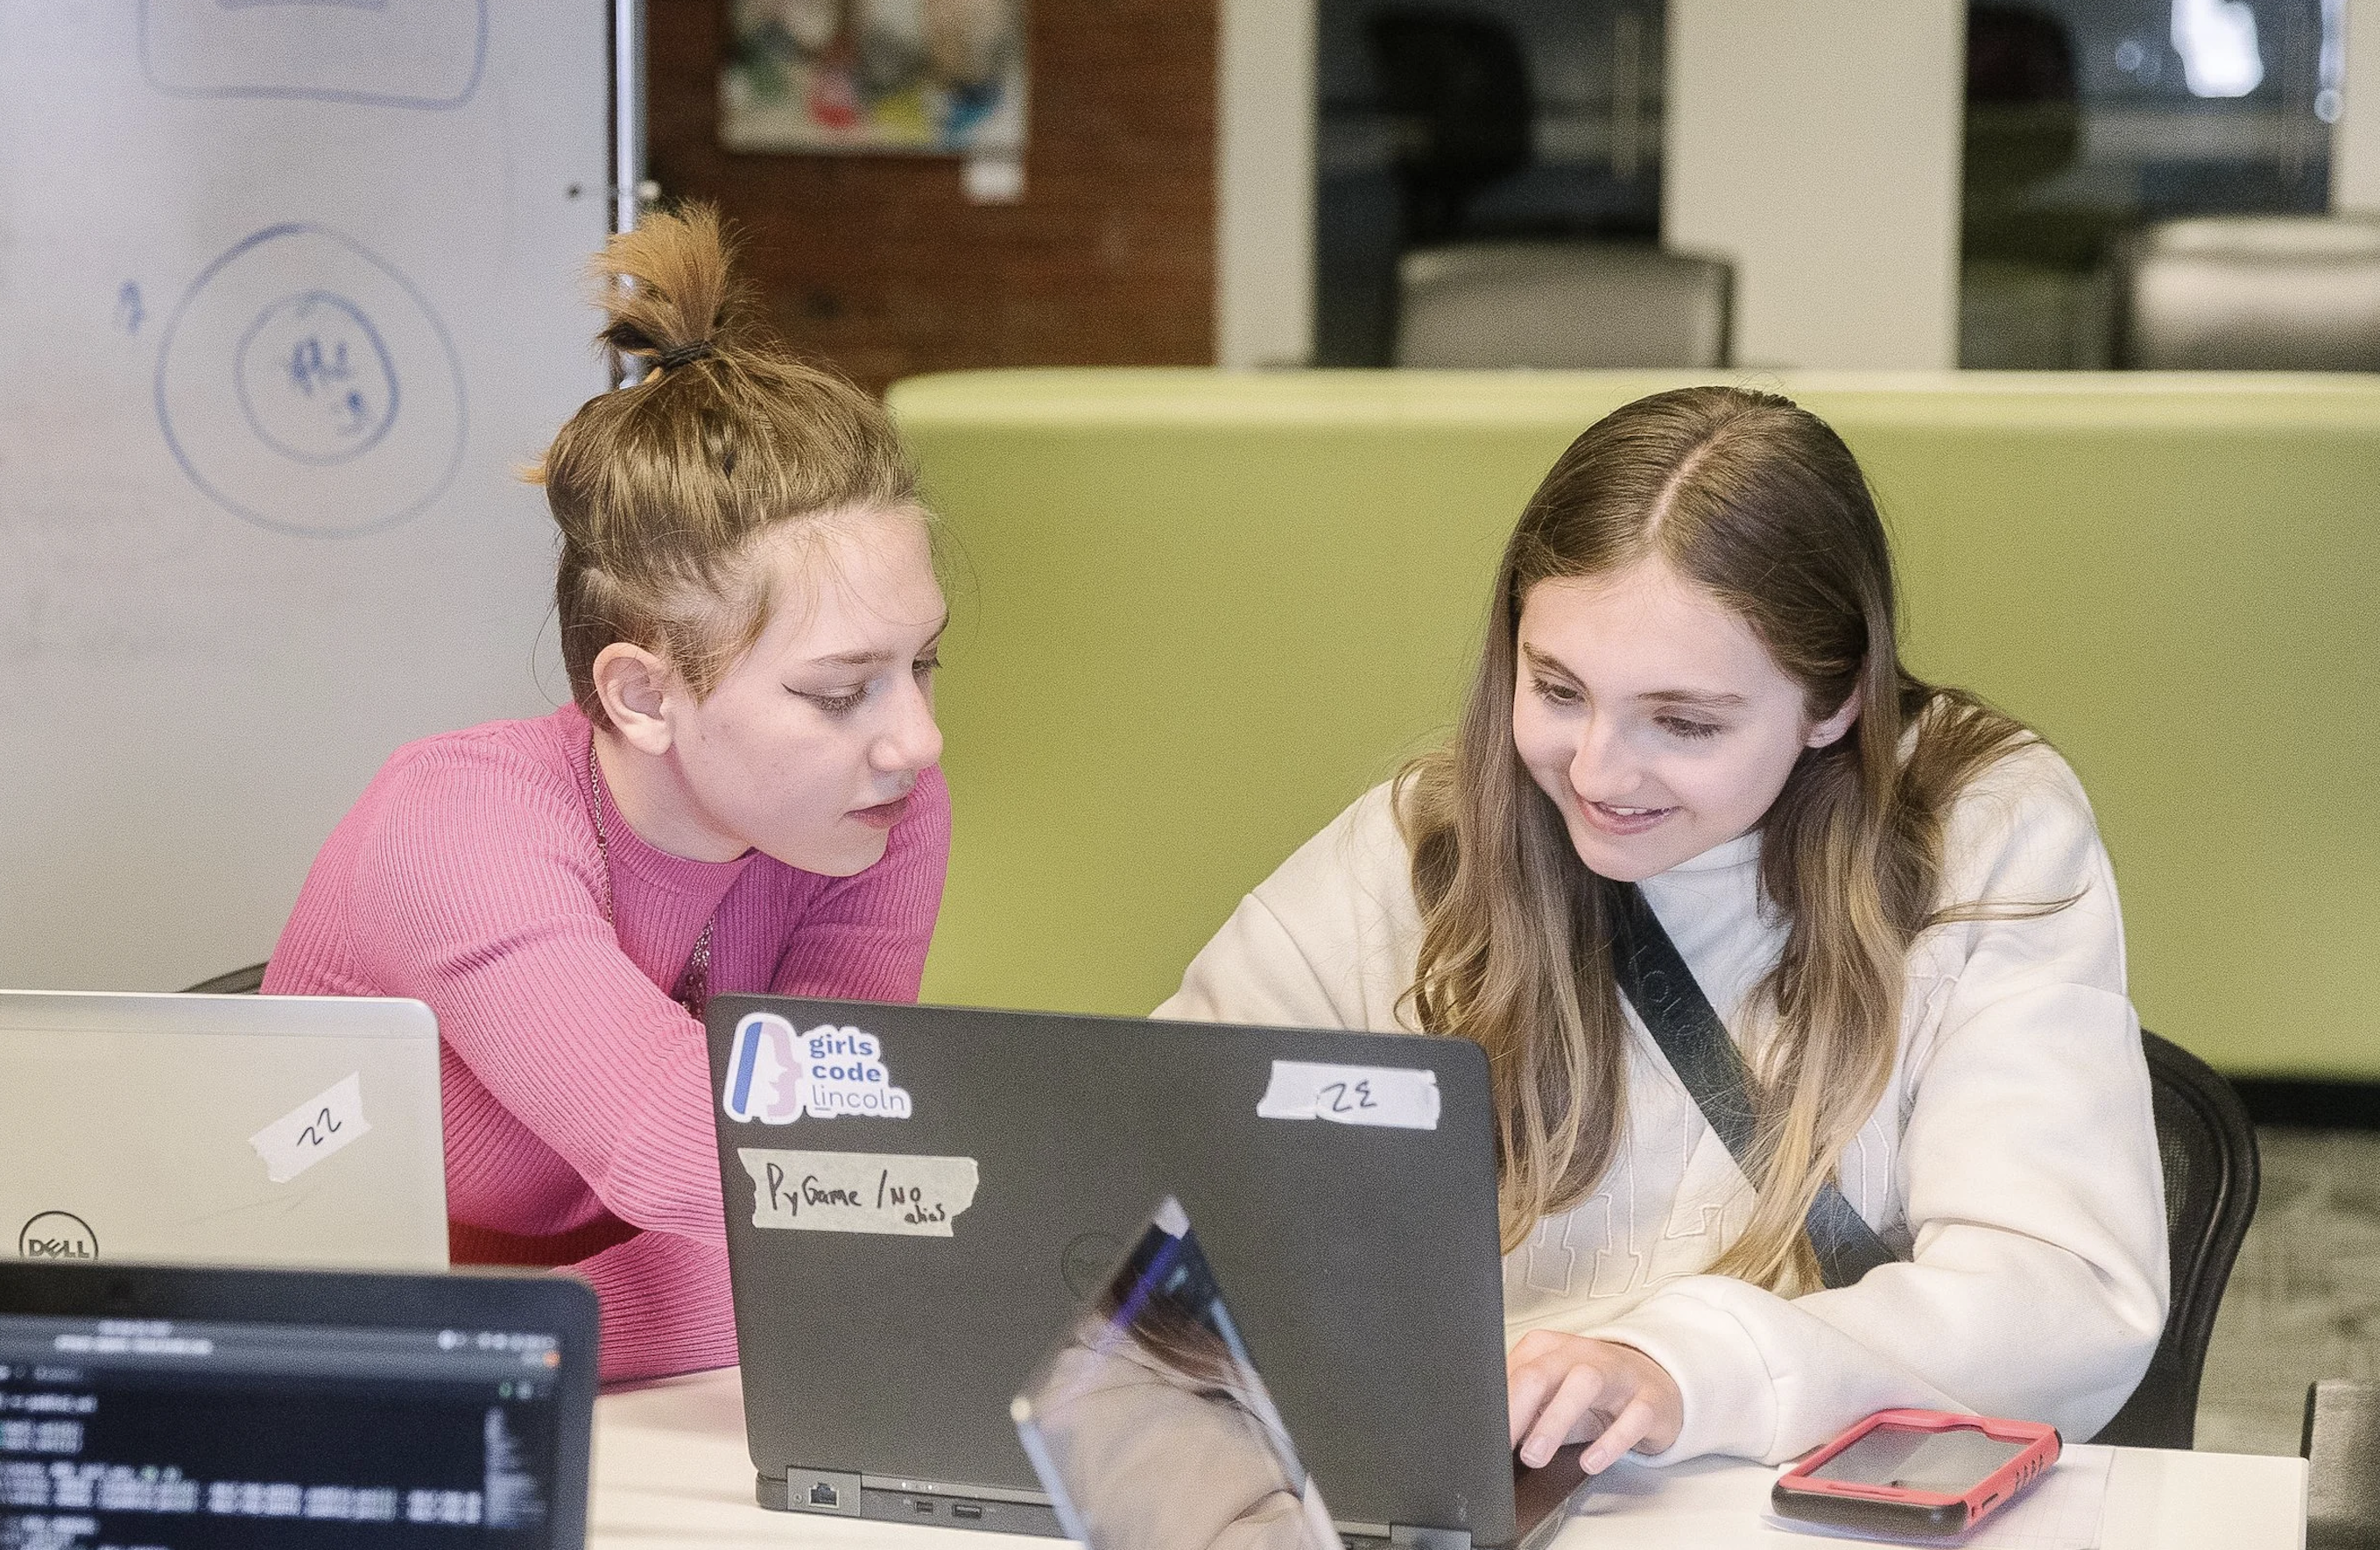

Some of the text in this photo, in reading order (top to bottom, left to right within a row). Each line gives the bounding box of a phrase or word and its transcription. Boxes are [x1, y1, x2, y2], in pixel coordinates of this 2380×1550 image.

[809, 1034, 873, 1059] girls
[812, 1062, 881, 1082] code
[812, 1085, 905, 1111] lincoln
[296, 1107, 342, 1147] 22
[904, 1203, 946, 1224] alias
[29, 1237, 90, 1260] DELL
